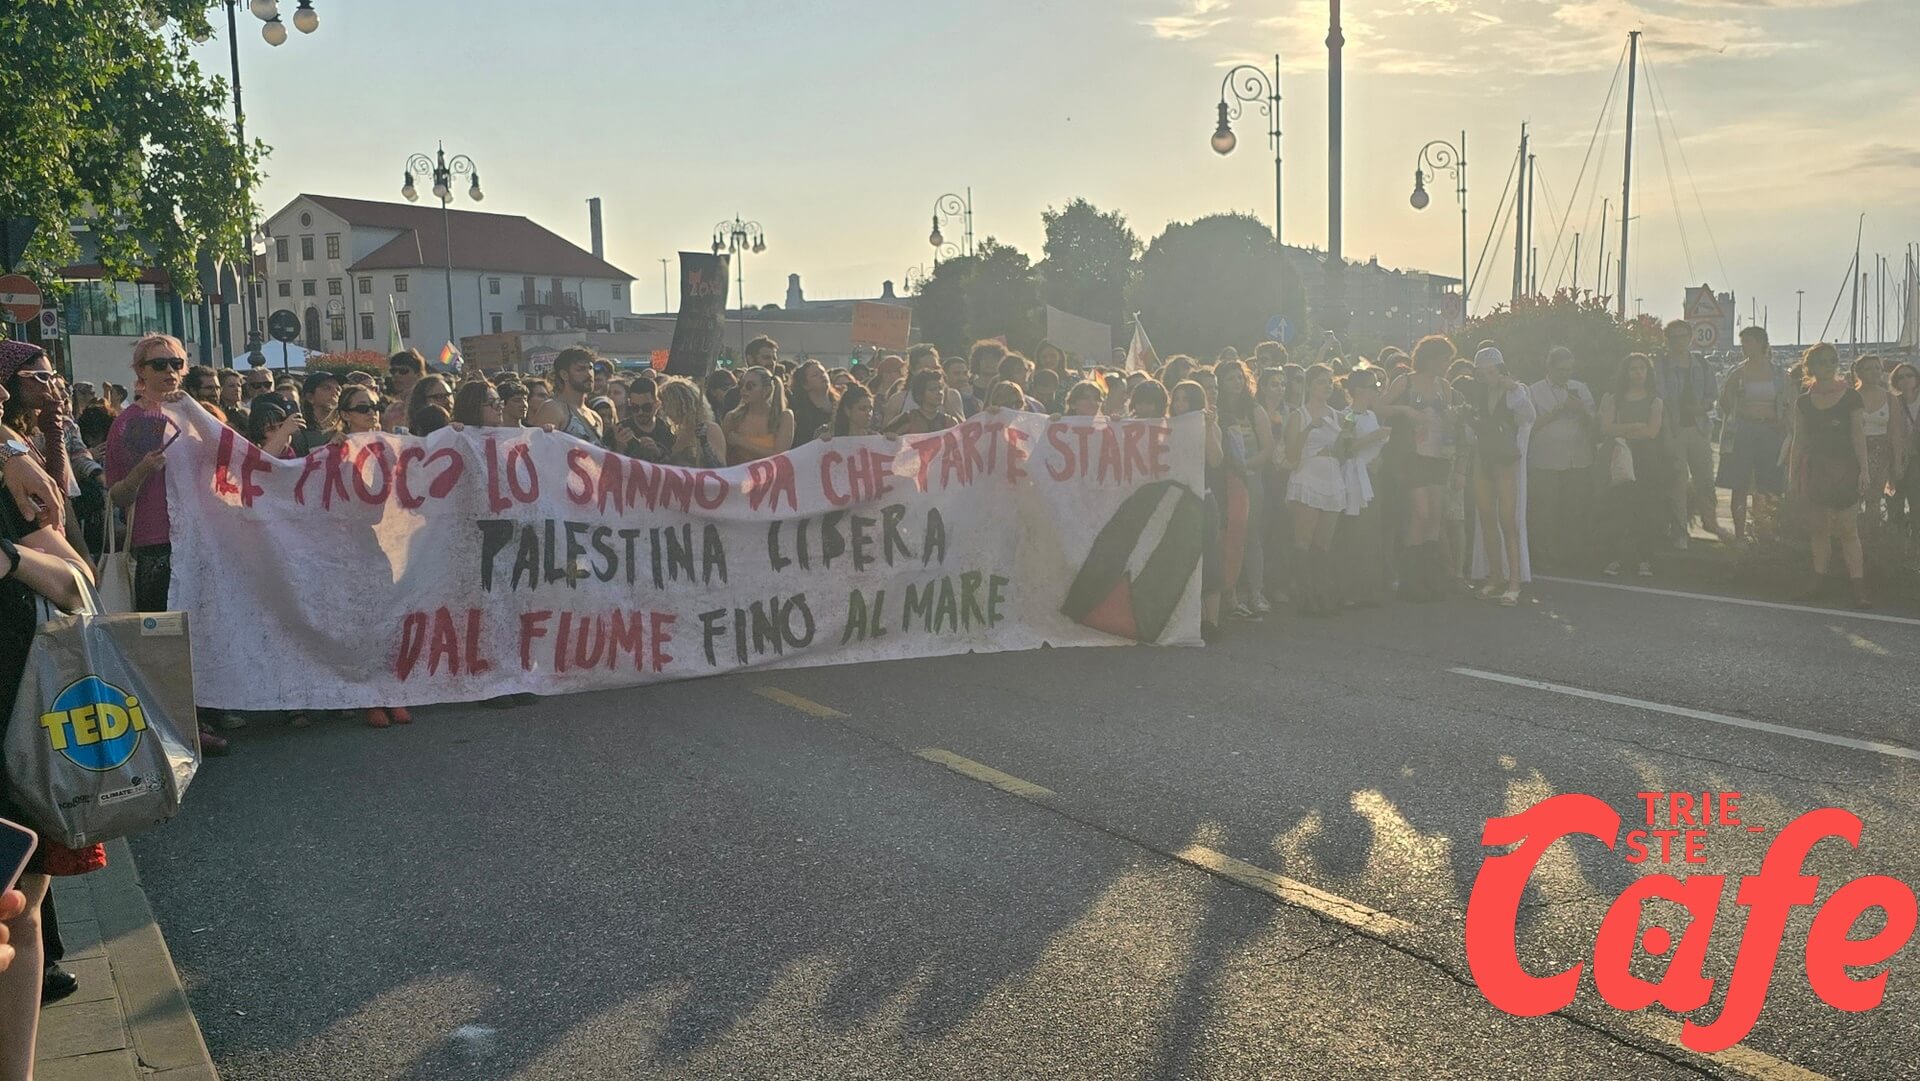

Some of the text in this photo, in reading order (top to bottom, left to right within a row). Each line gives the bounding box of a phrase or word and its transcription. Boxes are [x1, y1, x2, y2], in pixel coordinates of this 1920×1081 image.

[1697, 328, 1713, 341] 30
[214, 427, 273, 508] LE
[485, 437, 540, 516] LO
[566, 448, 730, 517] SANNO
[747, 455, 798, 514] DA
[820, 448, 897, 506] CHE
[911, 421, 1031, 493] PARTE
[1044, 423, 1173, 487] STARE
[477, 503, 946, 592] PALESTINA LIBERA
[395, 570, 1010, 682] DAL FIUME FINO AL MARE
[40, 695, 148, 751] TEDi
